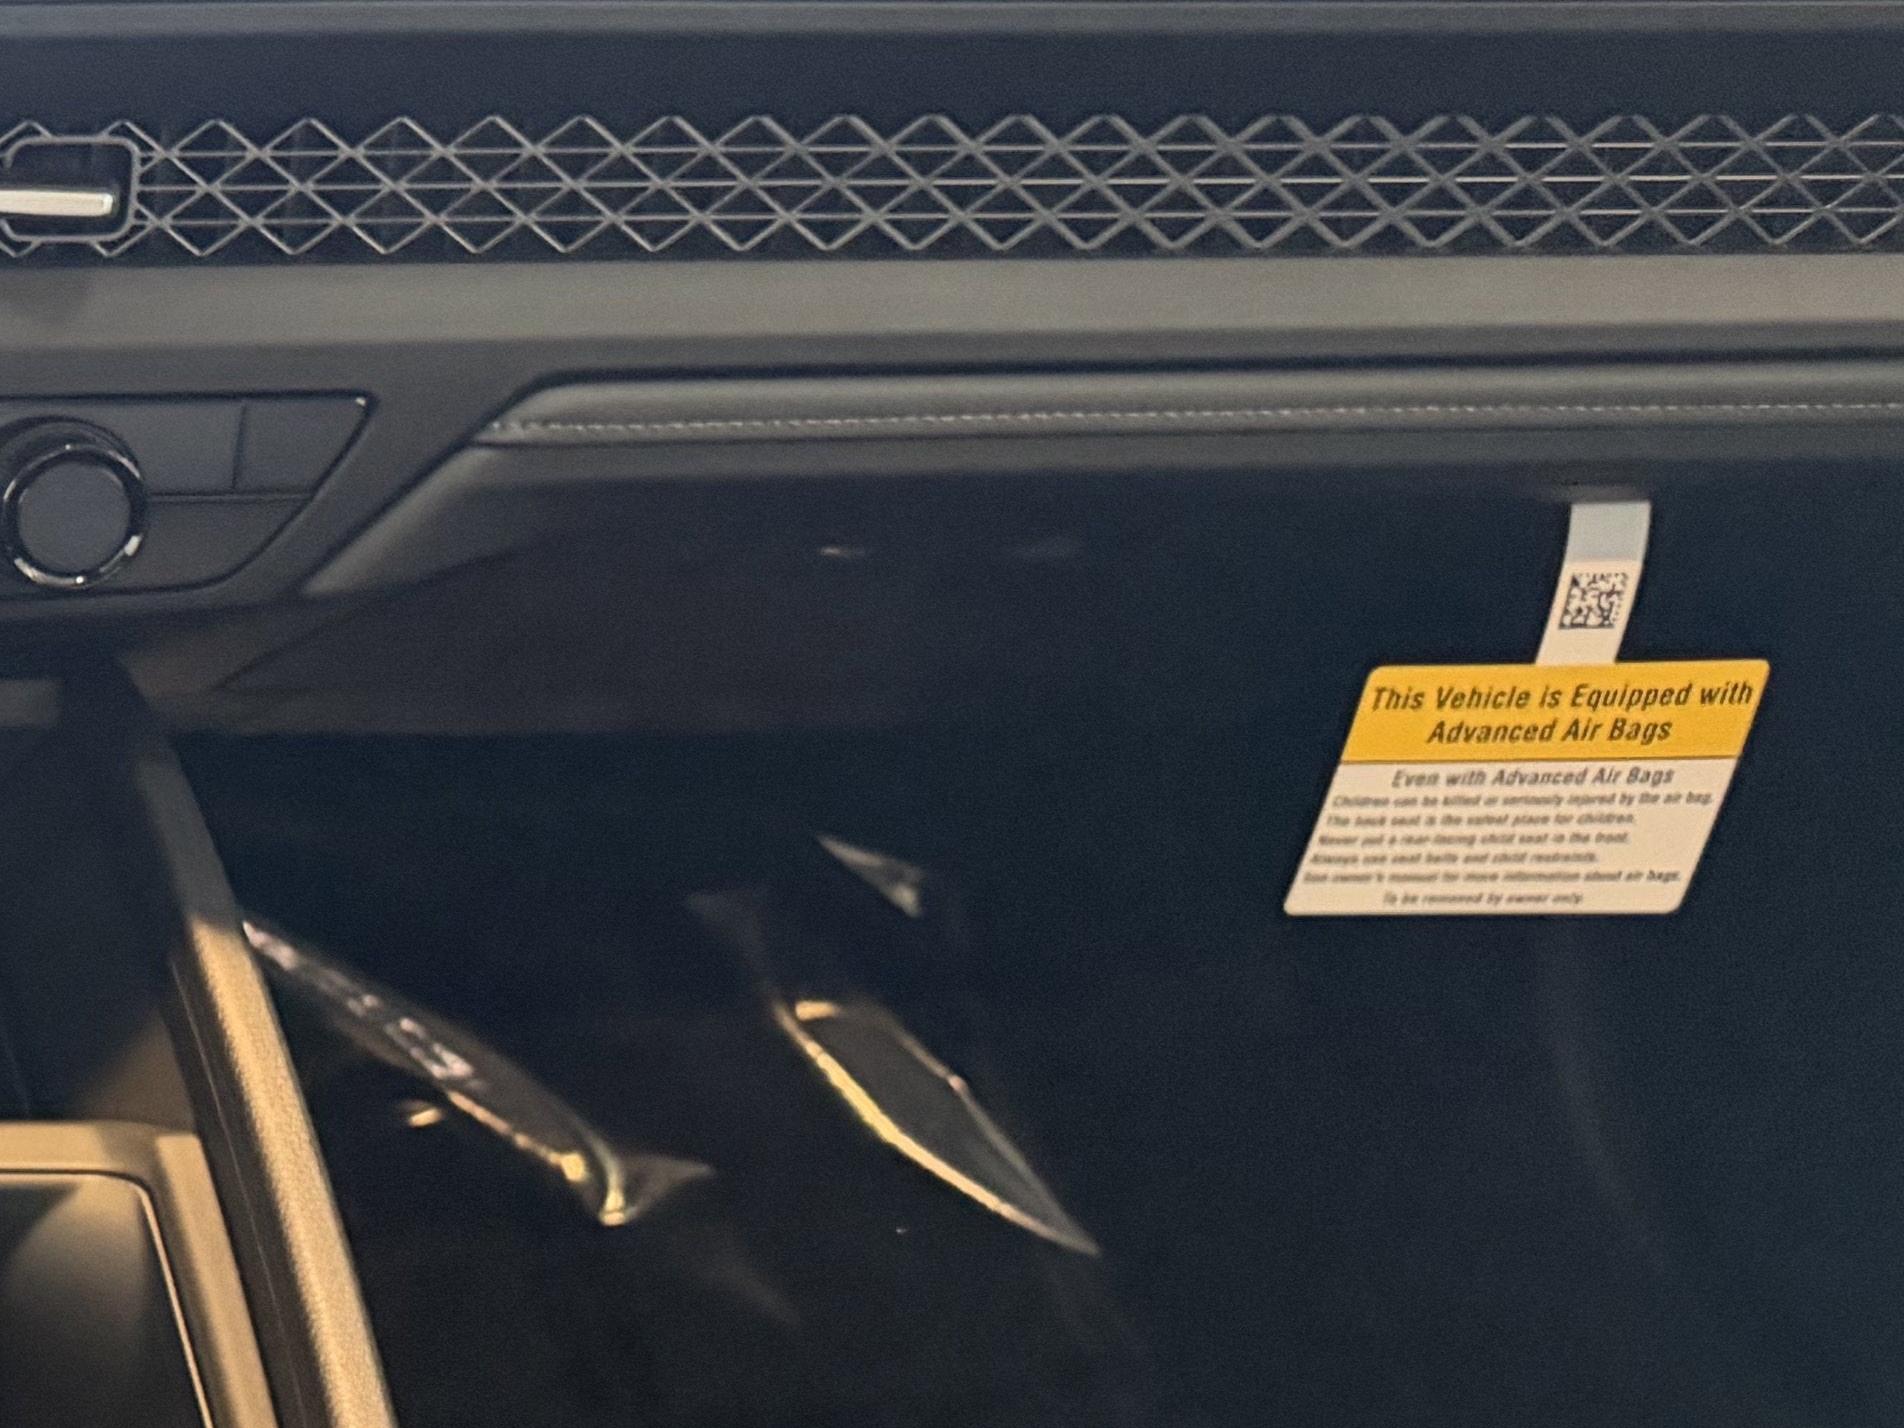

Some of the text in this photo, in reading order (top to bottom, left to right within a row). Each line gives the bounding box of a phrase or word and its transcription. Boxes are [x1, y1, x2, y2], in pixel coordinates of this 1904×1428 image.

[1372, 680, 1753, 713] This Vehicle is Equipped with
[1426, 716, 1673, 746] Advanced Air Bags
[1391, 766, 1675, 788] Even with Advanced Air Bags
